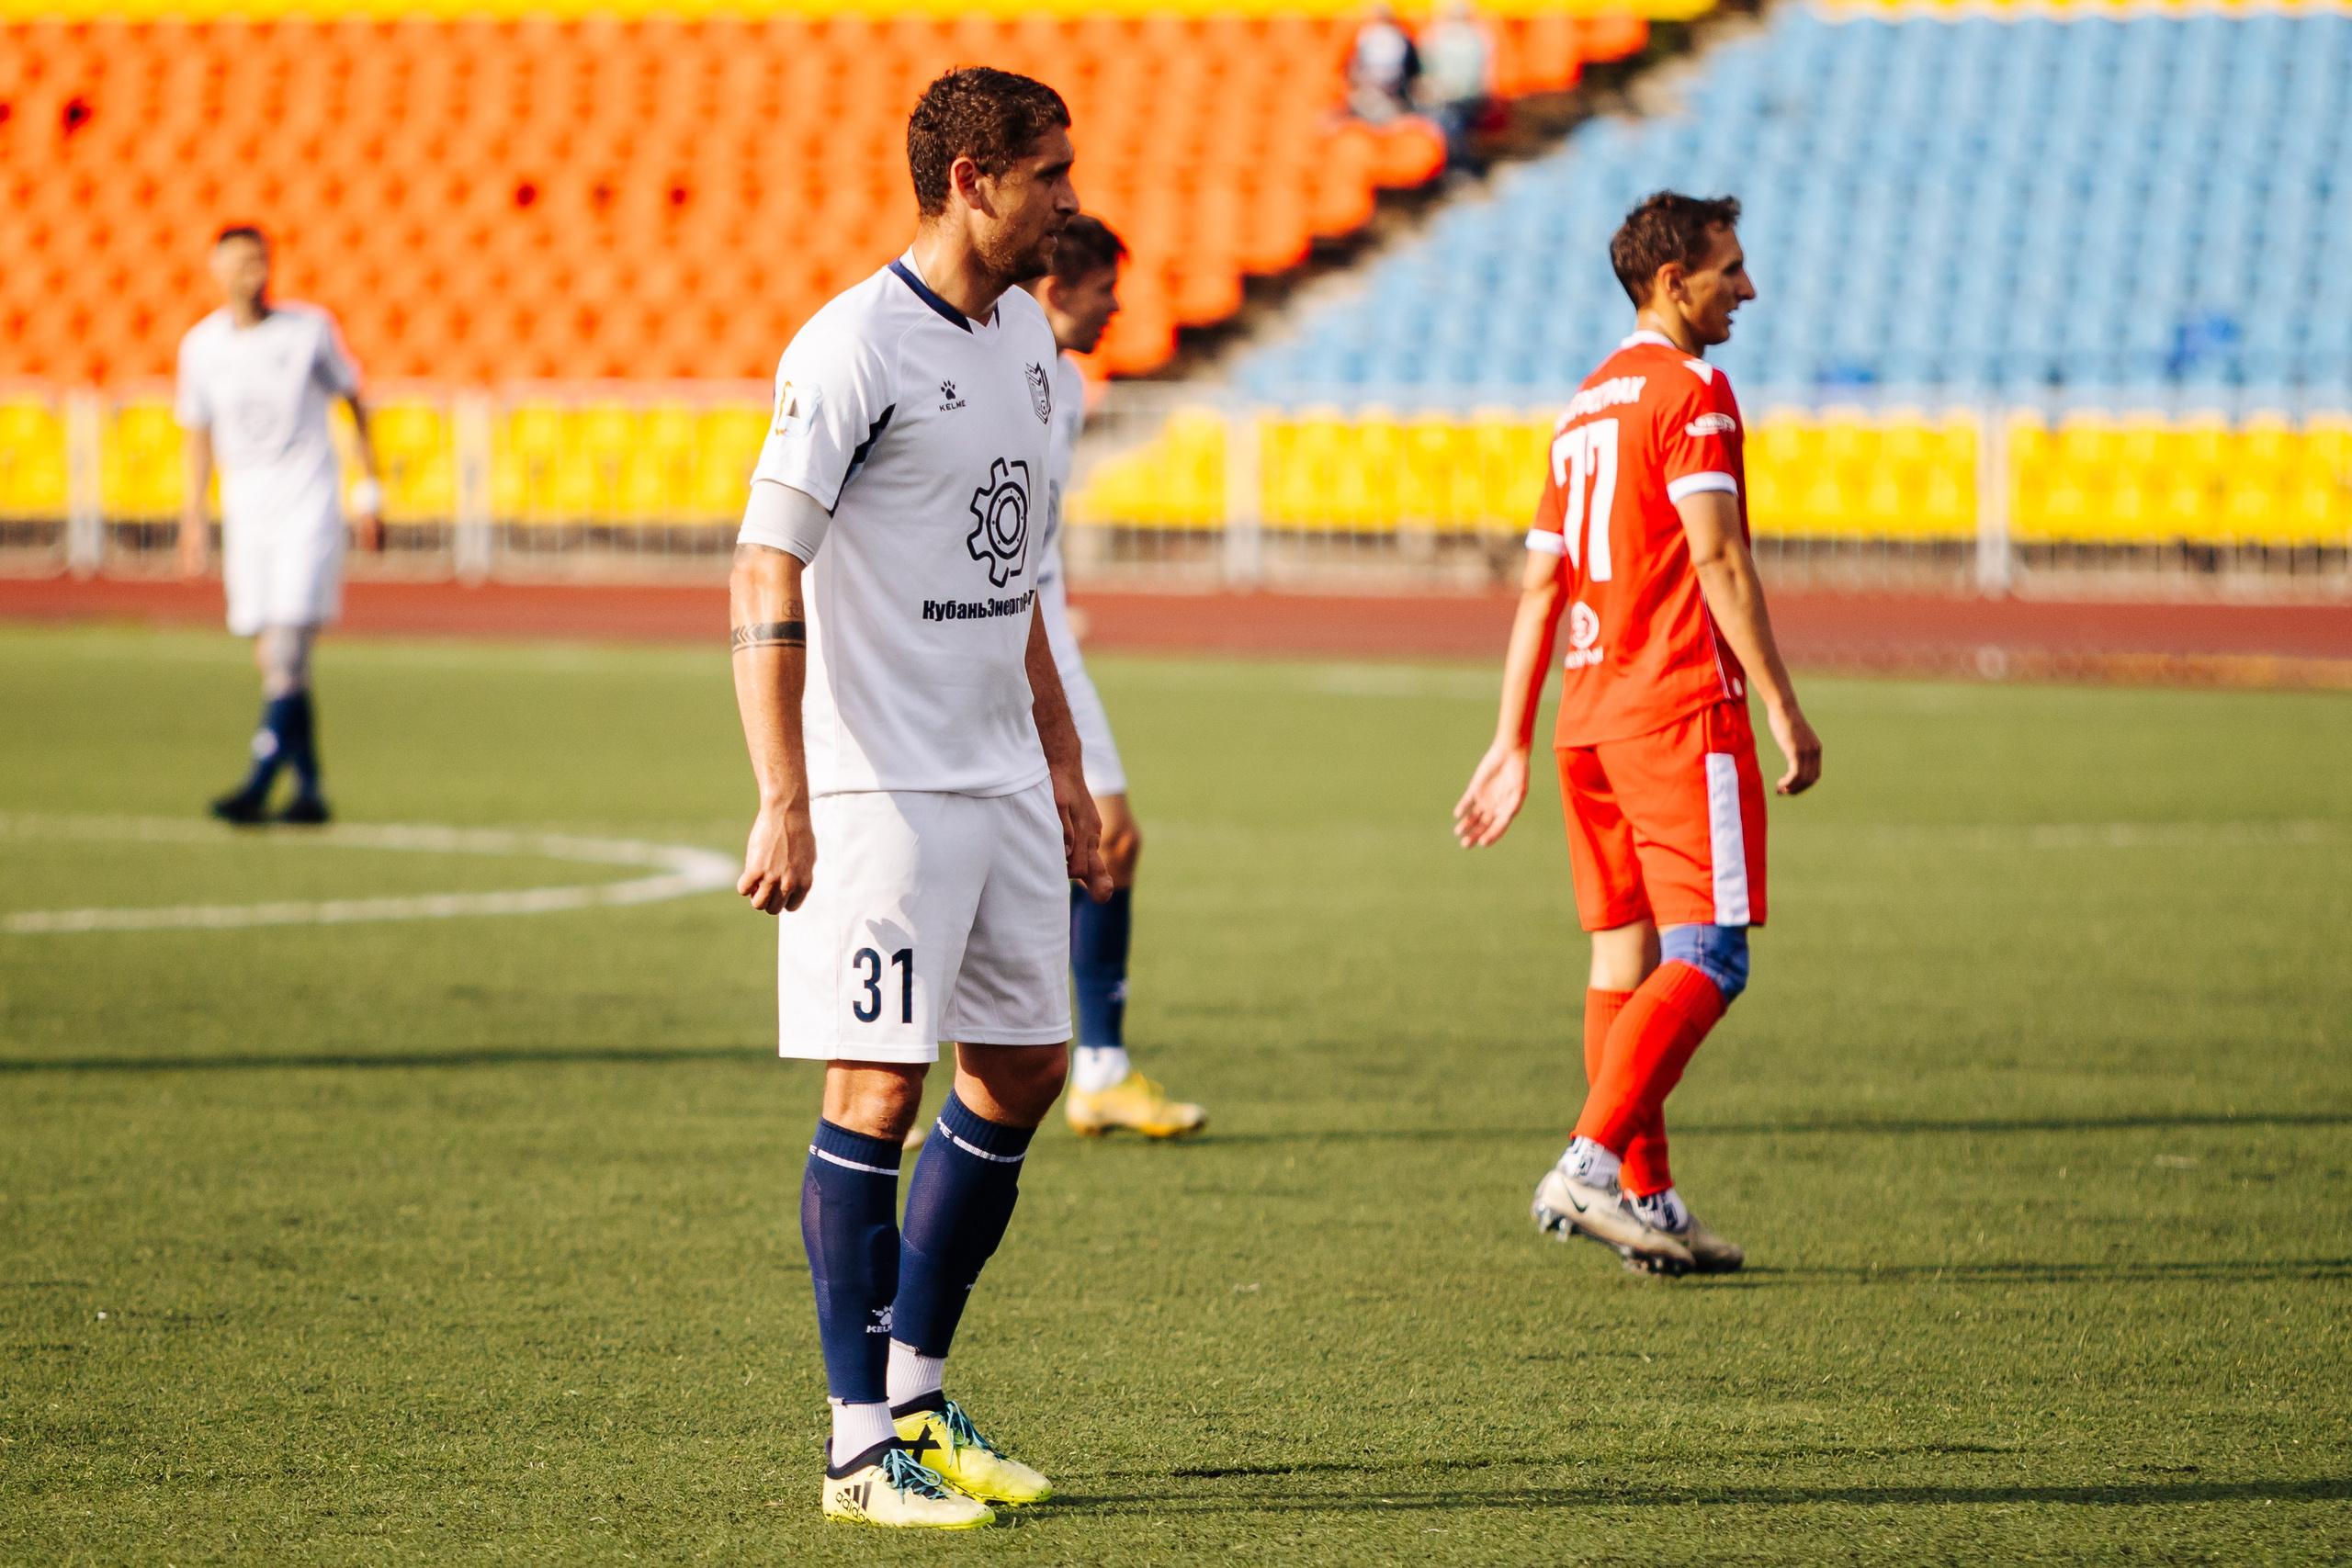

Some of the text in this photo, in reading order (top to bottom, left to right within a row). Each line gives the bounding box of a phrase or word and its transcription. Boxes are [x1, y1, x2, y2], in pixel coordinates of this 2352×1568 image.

[939, 400, 966, 412] KELME
[1552, 418, 1619, 581] 77
[853, 947, 913, 1024] 31
